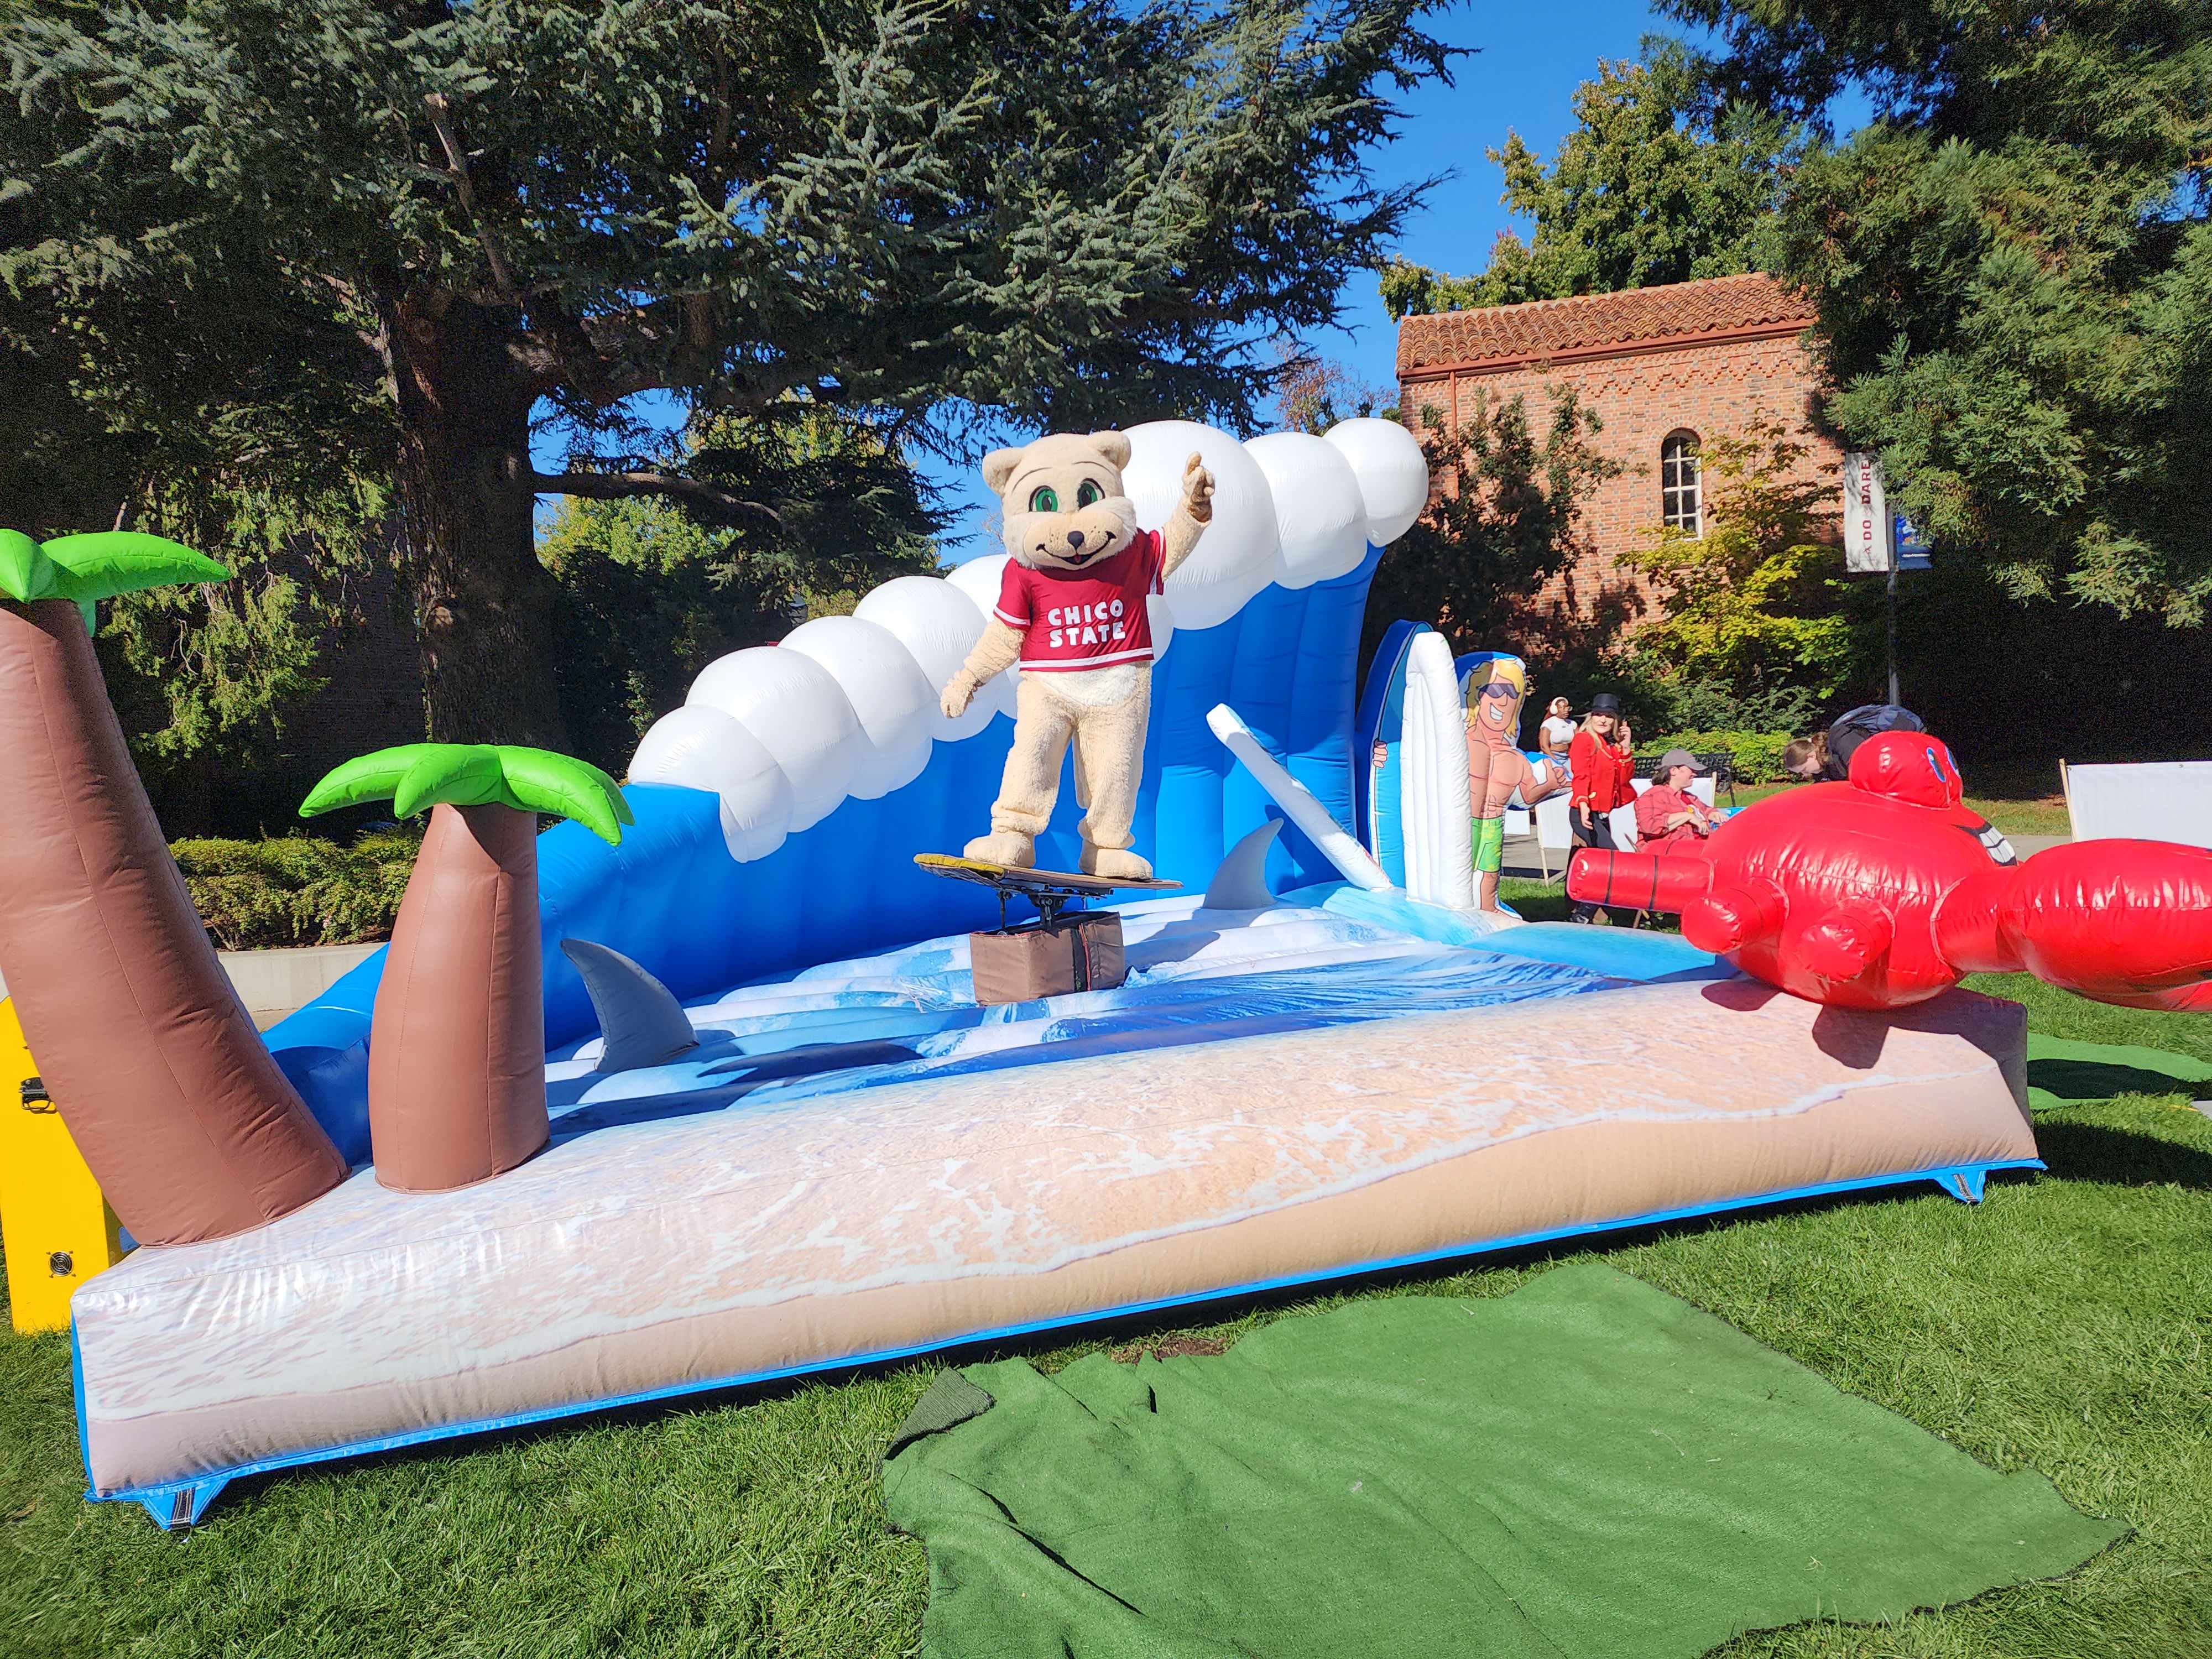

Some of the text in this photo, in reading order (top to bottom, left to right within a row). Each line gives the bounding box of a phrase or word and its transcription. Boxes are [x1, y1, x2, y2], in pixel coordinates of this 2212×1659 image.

[1861, 460, 1871, 504] DARE
[1863, 520, 1872, 540] DO
[1048, 599, 1123, 625] CHICO
[1050, 622, 1125, 648] STATE
